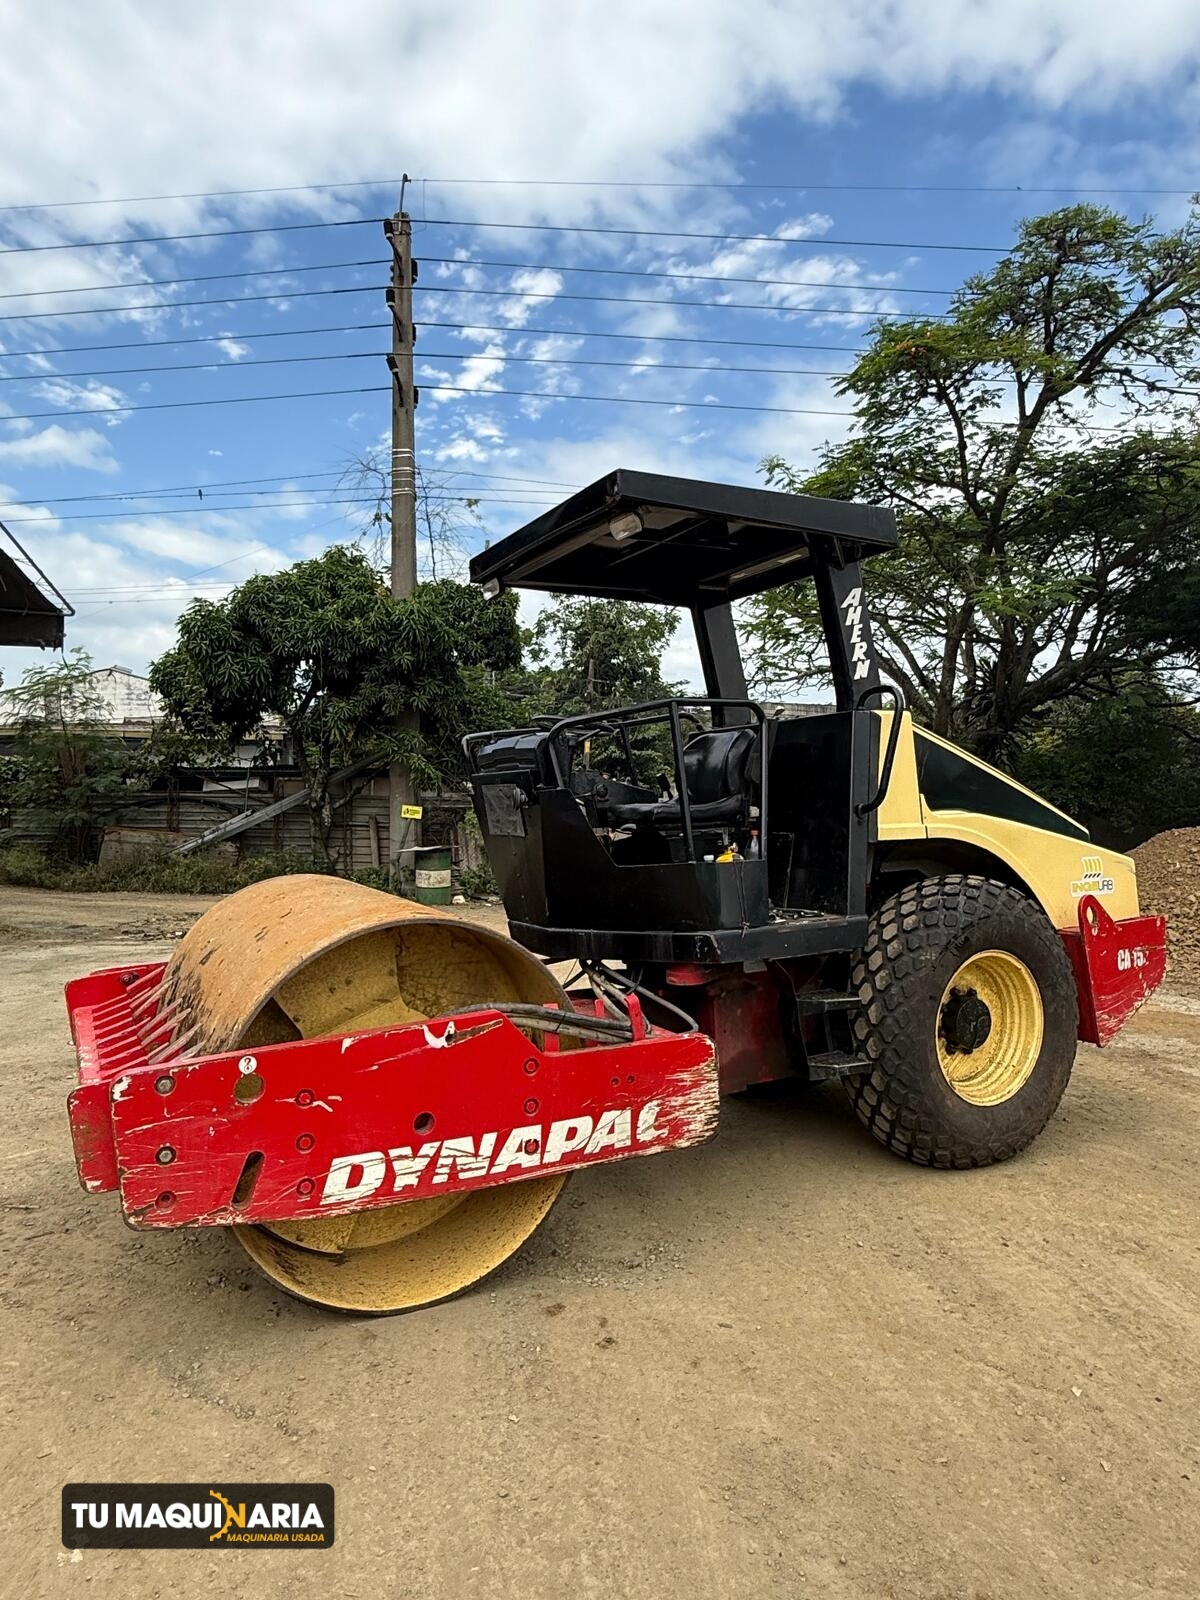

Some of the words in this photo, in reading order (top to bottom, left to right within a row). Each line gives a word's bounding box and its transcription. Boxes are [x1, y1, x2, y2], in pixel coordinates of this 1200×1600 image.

[840, 587, 871, 680] AHERN
[1117, 948, 1132, 971] CA
[320, 1099, 670, 1205] DYNAPAC
